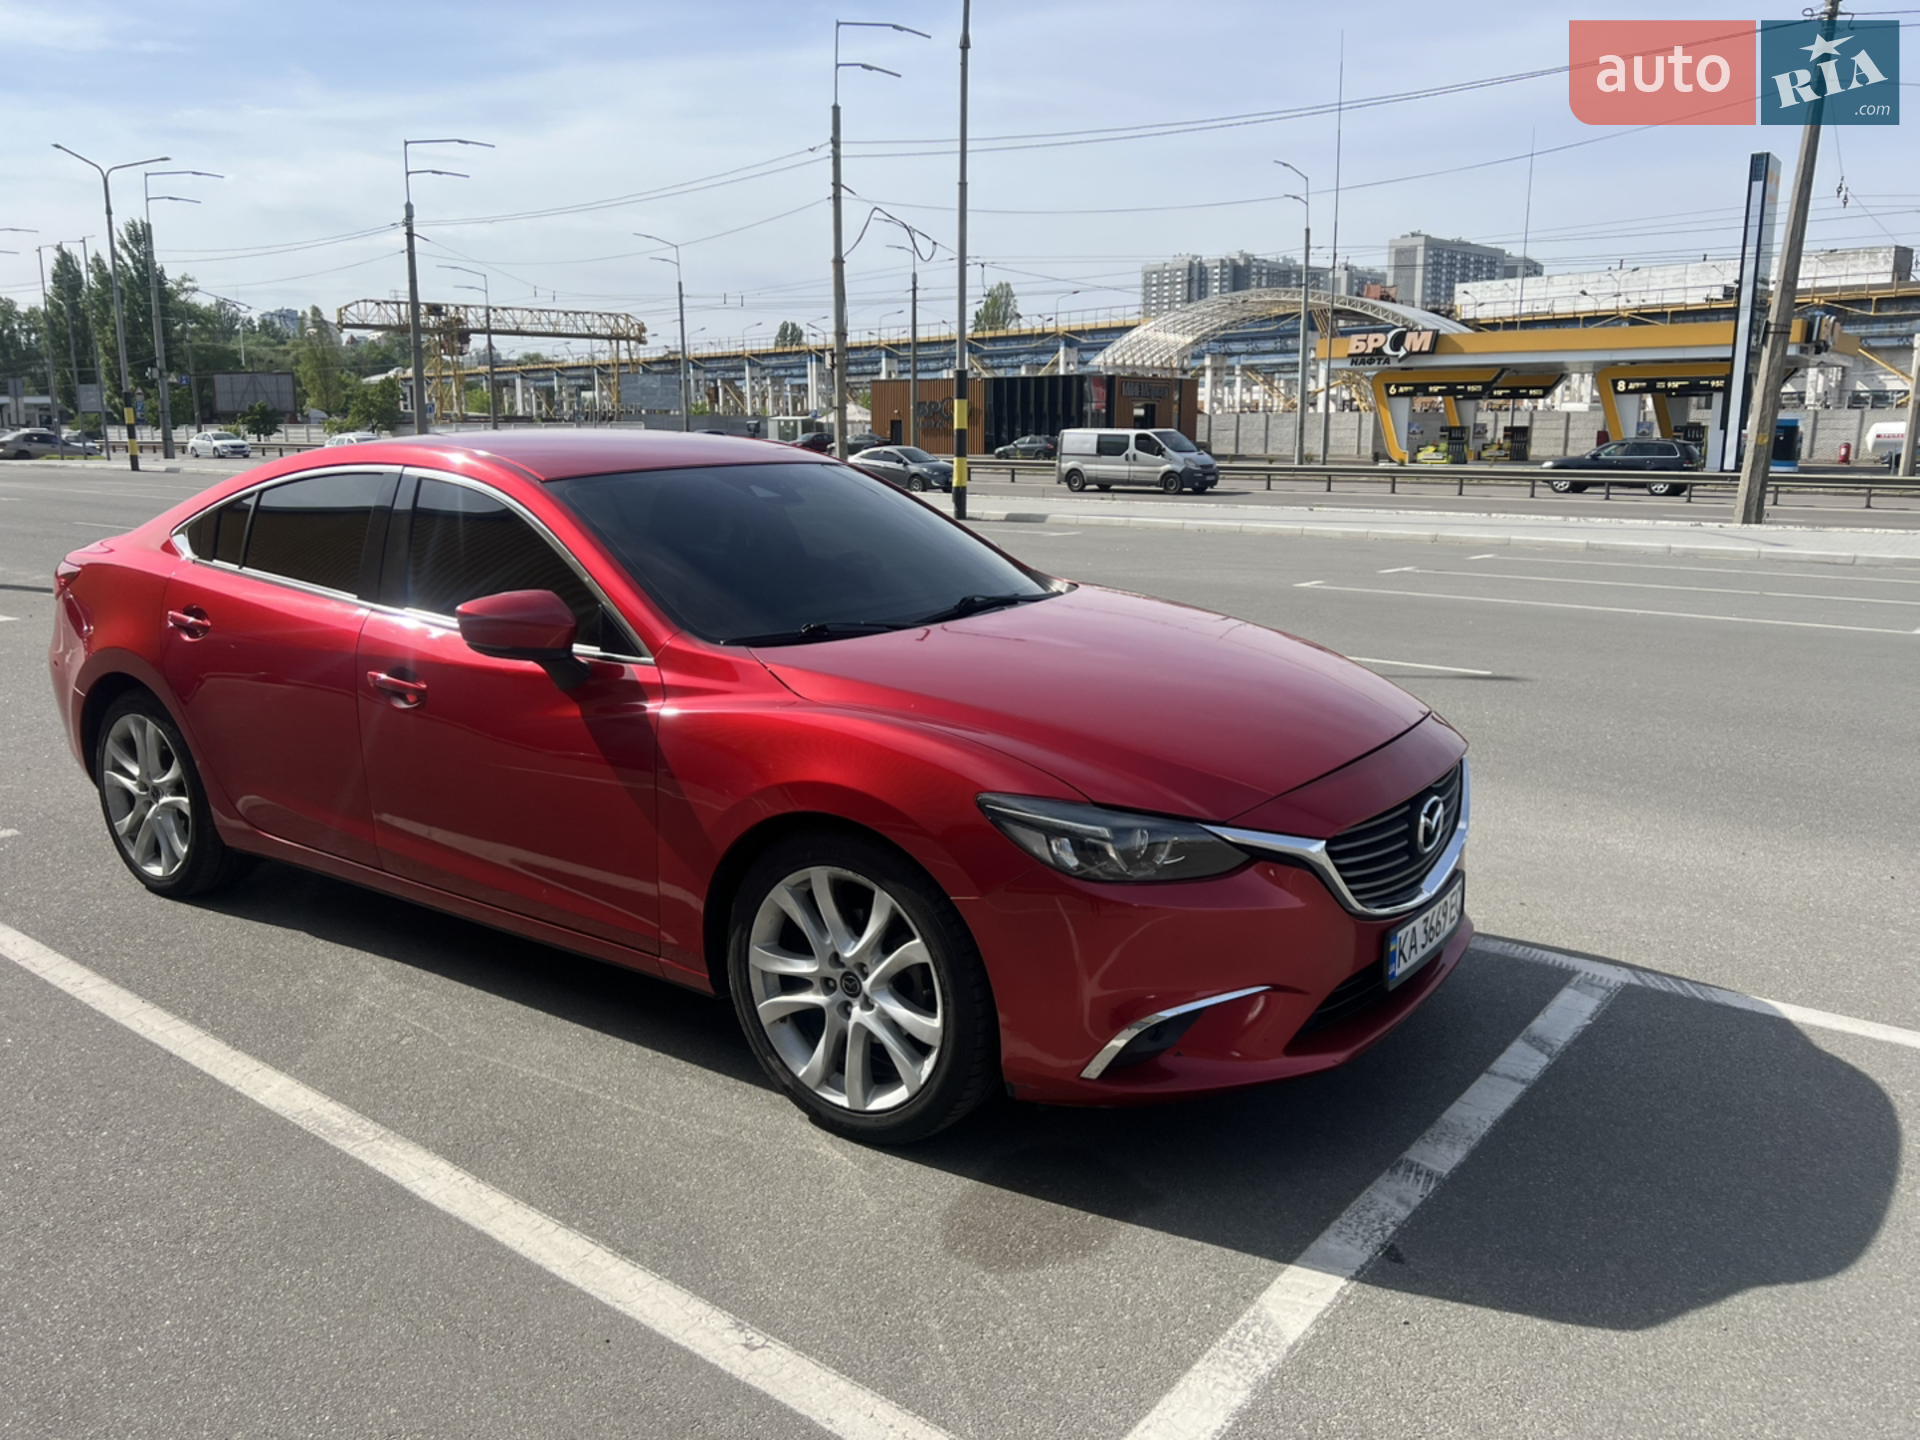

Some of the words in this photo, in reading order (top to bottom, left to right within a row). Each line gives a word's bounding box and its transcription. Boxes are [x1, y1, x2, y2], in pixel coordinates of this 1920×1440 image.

[1347, 328, 1433, 358] БРСМ
[1350, 357, 1391, 367] НАФТА
[1388, 384, 1397, 395] 6
[1617, 380, 1626, 392] 8
[1397, 925, 1418, 969] KA
[1421, 900, 1449, 950] 3669
